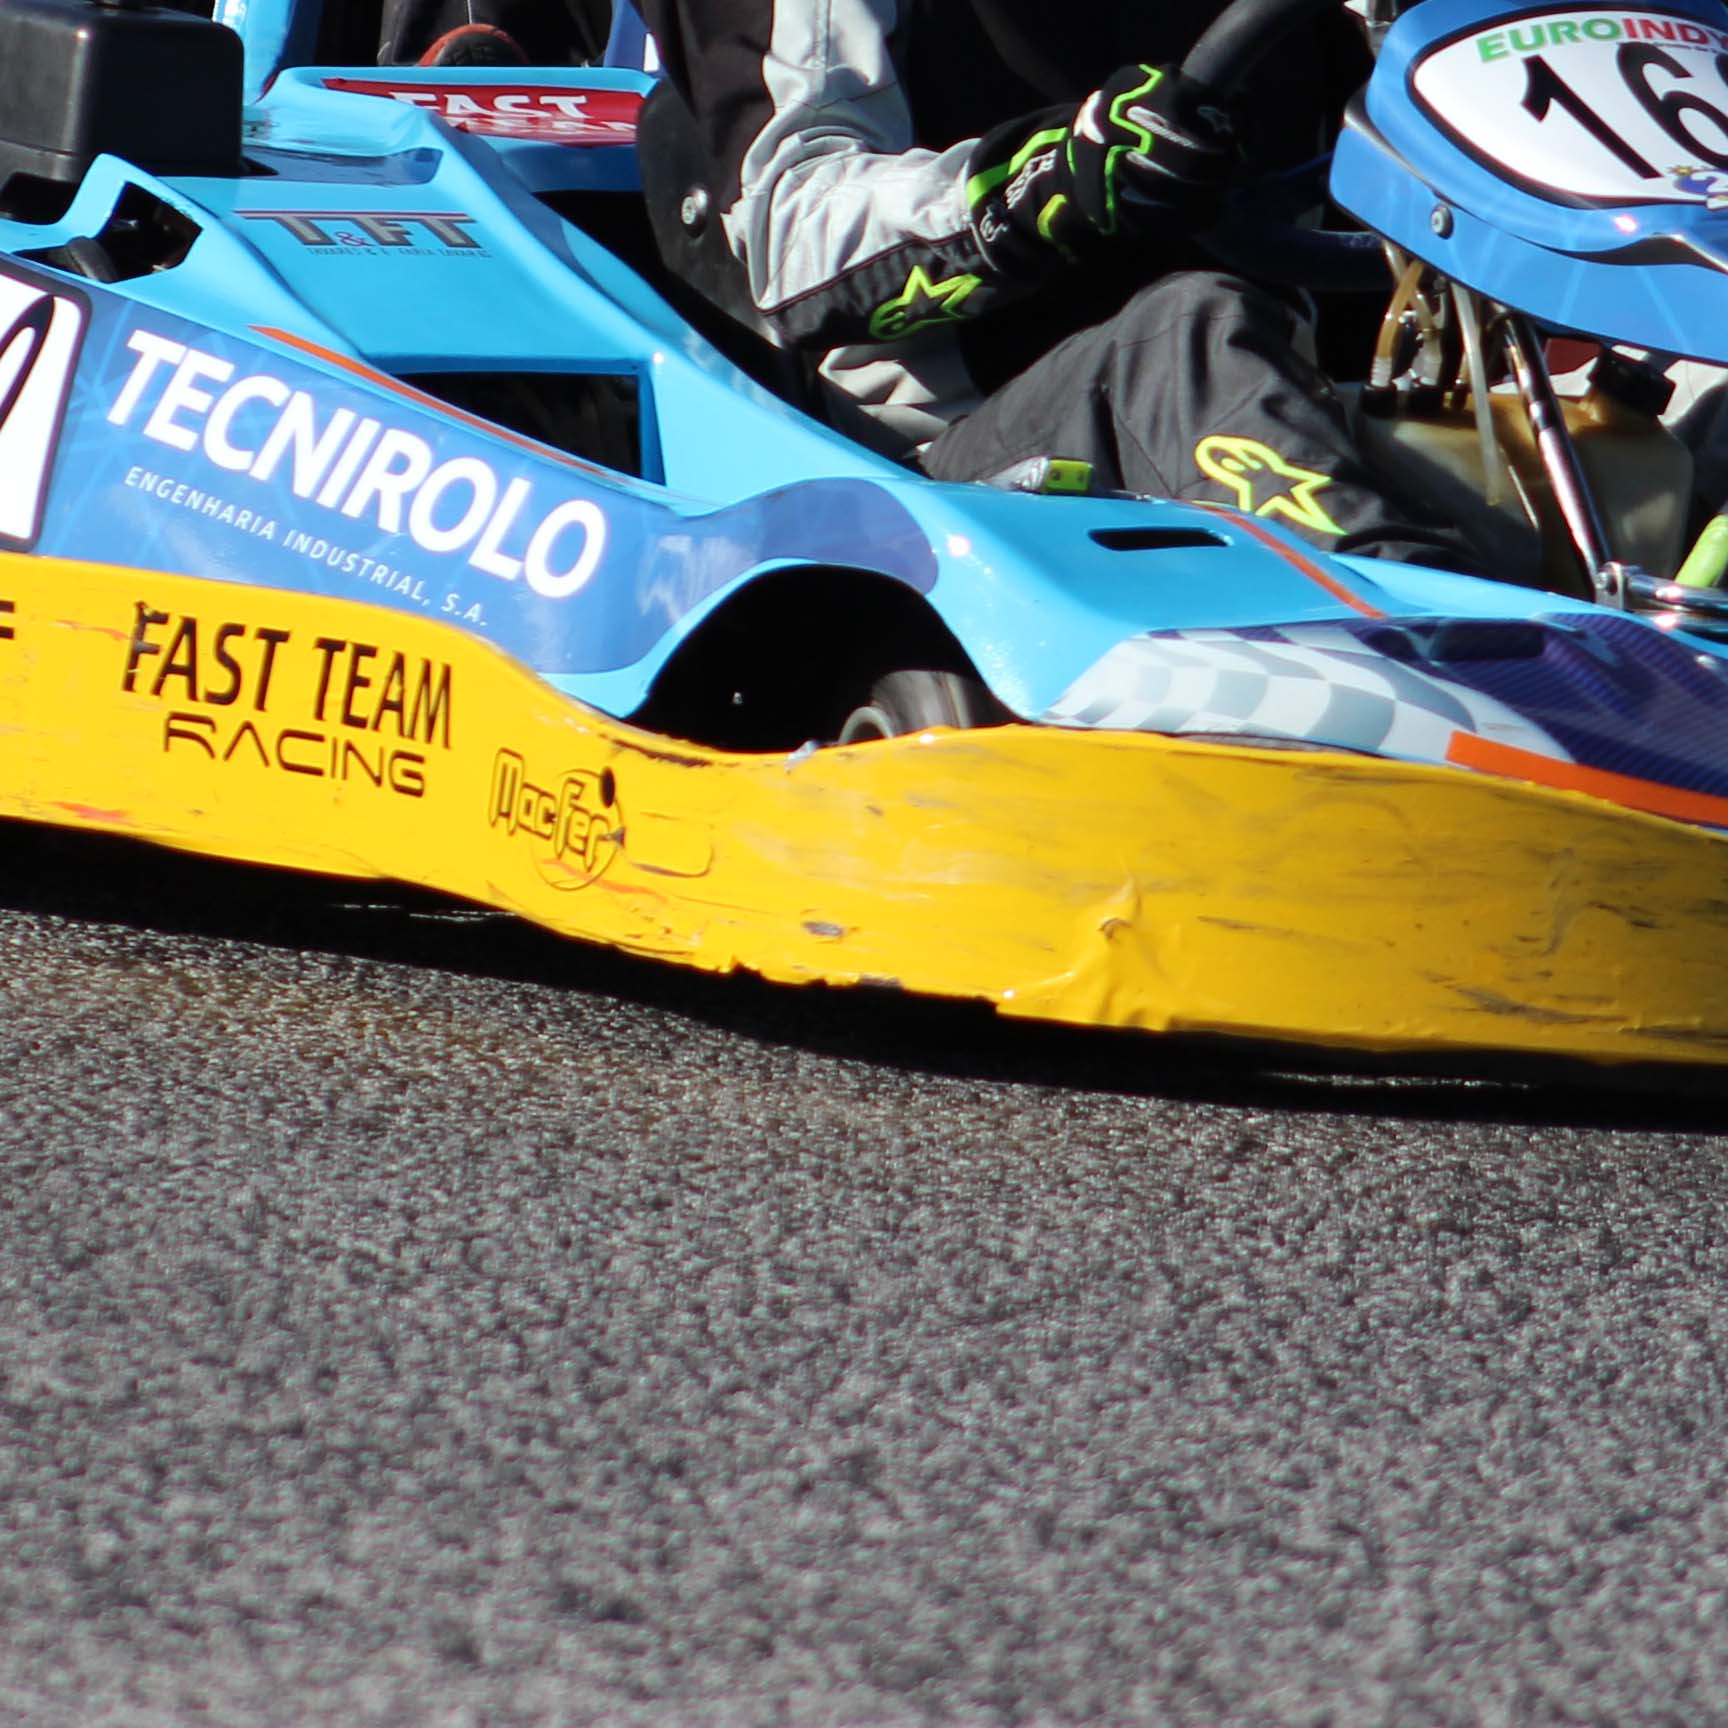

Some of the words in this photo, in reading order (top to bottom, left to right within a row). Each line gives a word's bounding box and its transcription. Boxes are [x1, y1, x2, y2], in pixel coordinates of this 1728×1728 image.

[106, 329, 608, 600] TECNIROLO
[124, 465, 275, 542] ENGENHARIA
[282, 528, 432, 608] INDUSTRIAL,
[441, 593, 489, 627] S.A.
[121, 601, 290, 713] FAST
[314, 637, 454, 751] TEAM
[163, 710, 426, 798] RACING
